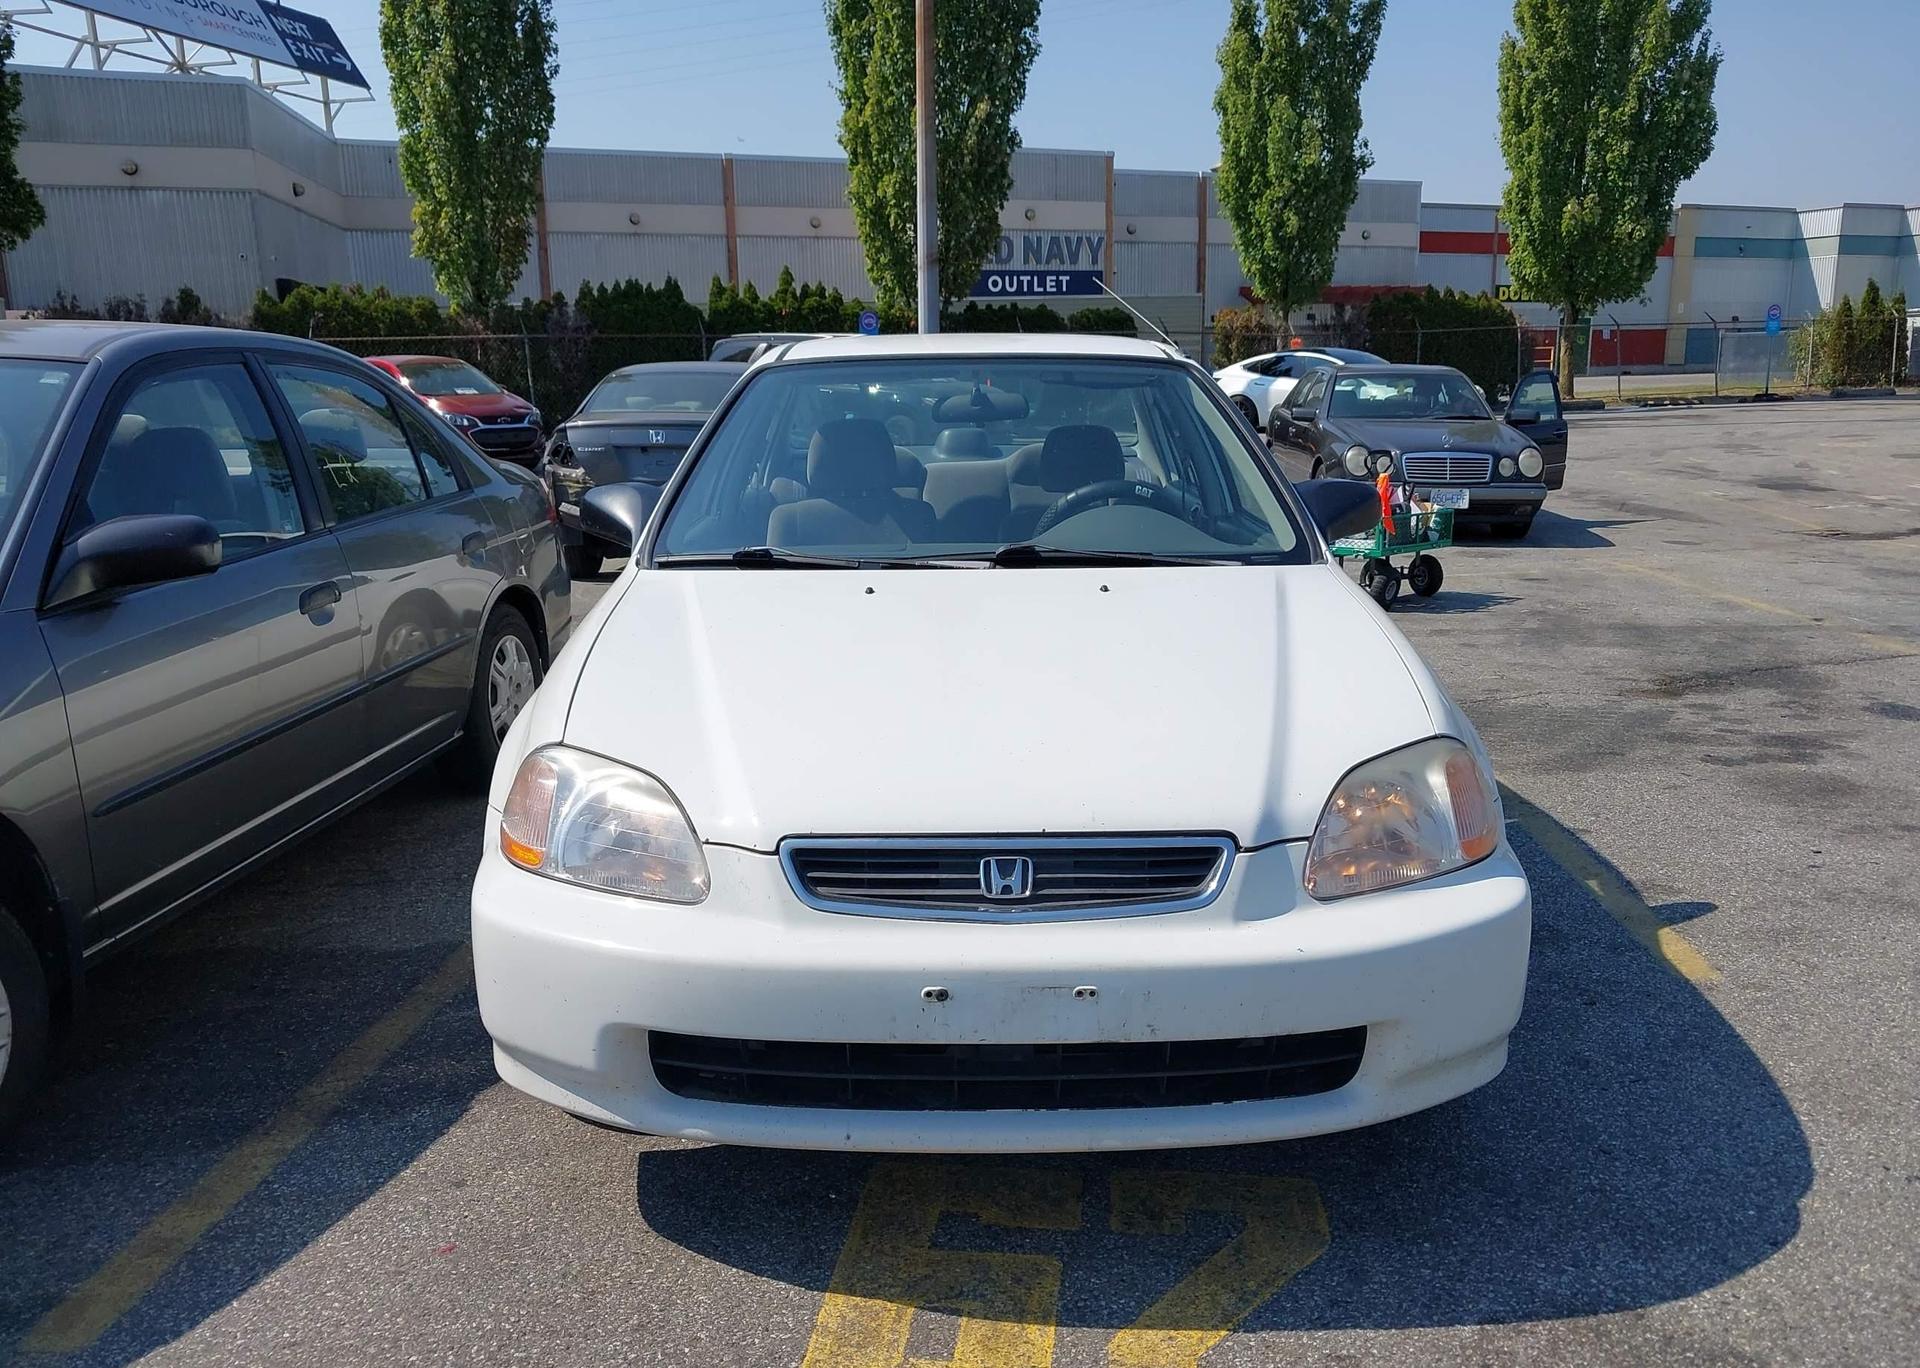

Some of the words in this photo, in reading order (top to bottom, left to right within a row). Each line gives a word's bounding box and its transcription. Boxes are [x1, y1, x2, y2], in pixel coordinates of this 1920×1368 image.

[174, 0, 267, 30] OROUGH
[269, 12, 313, 40] NEXT
[285, 38, 329, 64] EXIT
[1022, 235, 1104, 265] NAVY
[987, 275, 1070, 292] OUTLET
[1135, 485, 1155, 498] CAT
